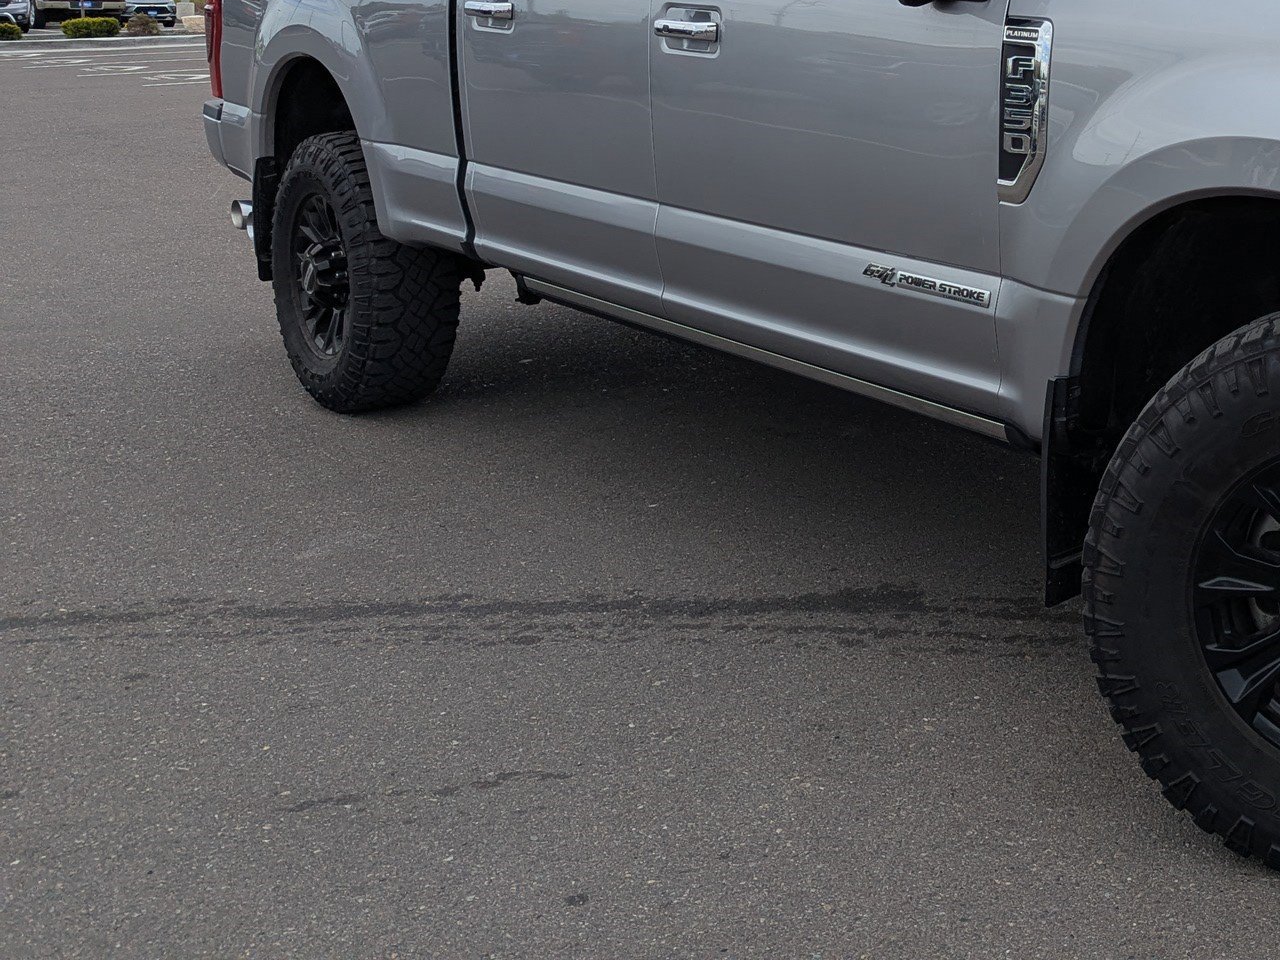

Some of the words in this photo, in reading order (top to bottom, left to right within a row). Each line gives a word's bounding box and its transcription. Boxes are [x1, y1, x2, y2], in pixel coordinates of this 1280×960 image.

[1006, 30, 1039, 38] PLATINUM
[898, 273, 938, 292] POWER
[938, 283, 986, 303] STROKE
